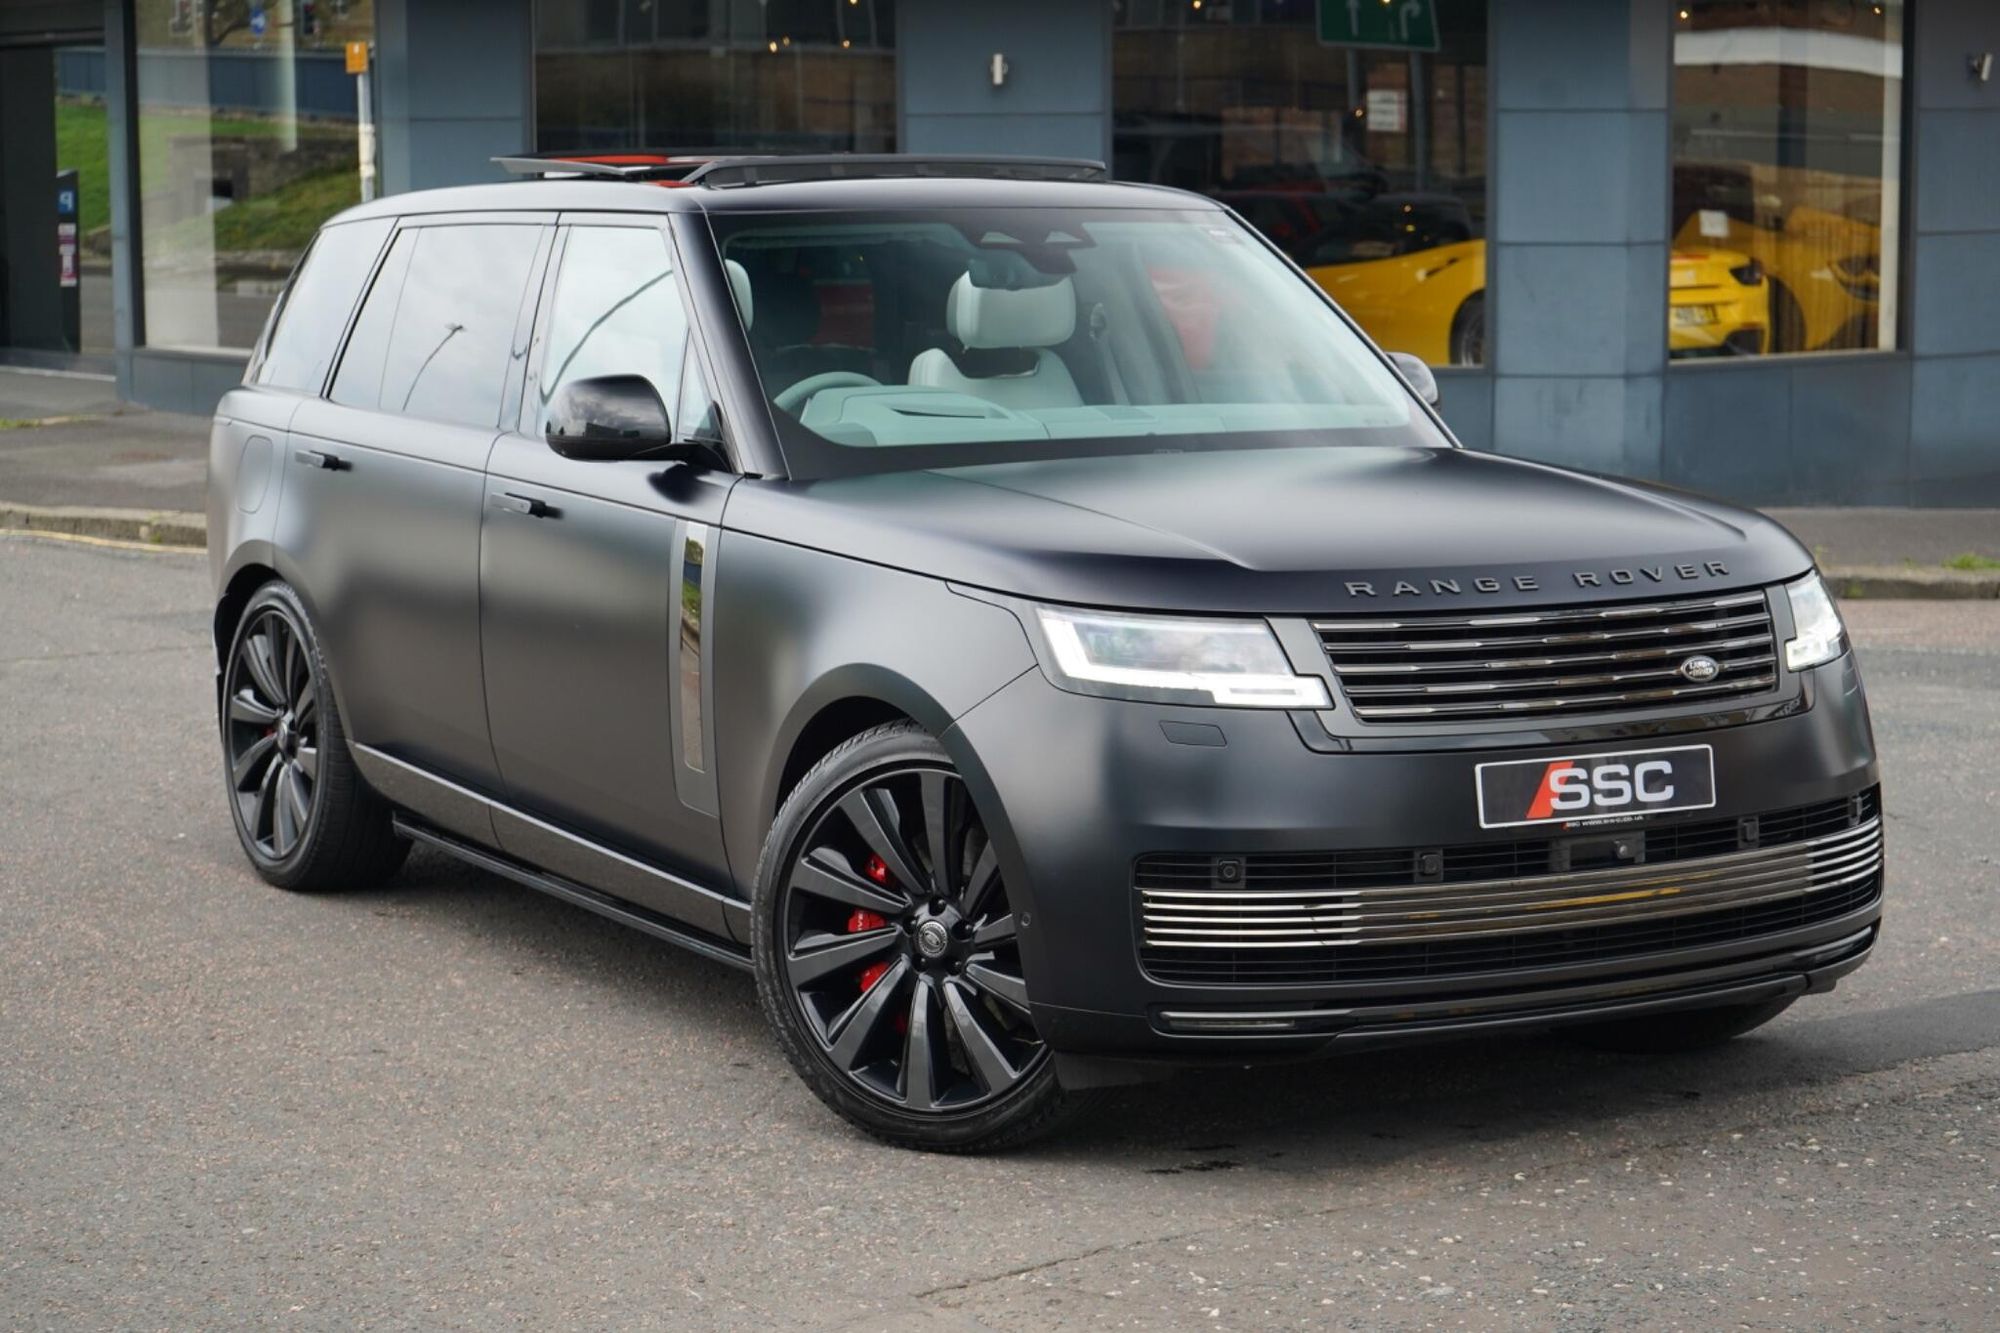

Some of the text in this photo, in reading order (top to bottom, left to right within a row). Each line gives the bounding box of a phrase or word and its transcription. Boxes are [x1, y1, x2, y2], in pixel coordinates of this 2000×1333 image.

[1344, 560, 1730, 597] RANGE ROVER
[1550, 761, 1674, 810] SSC
